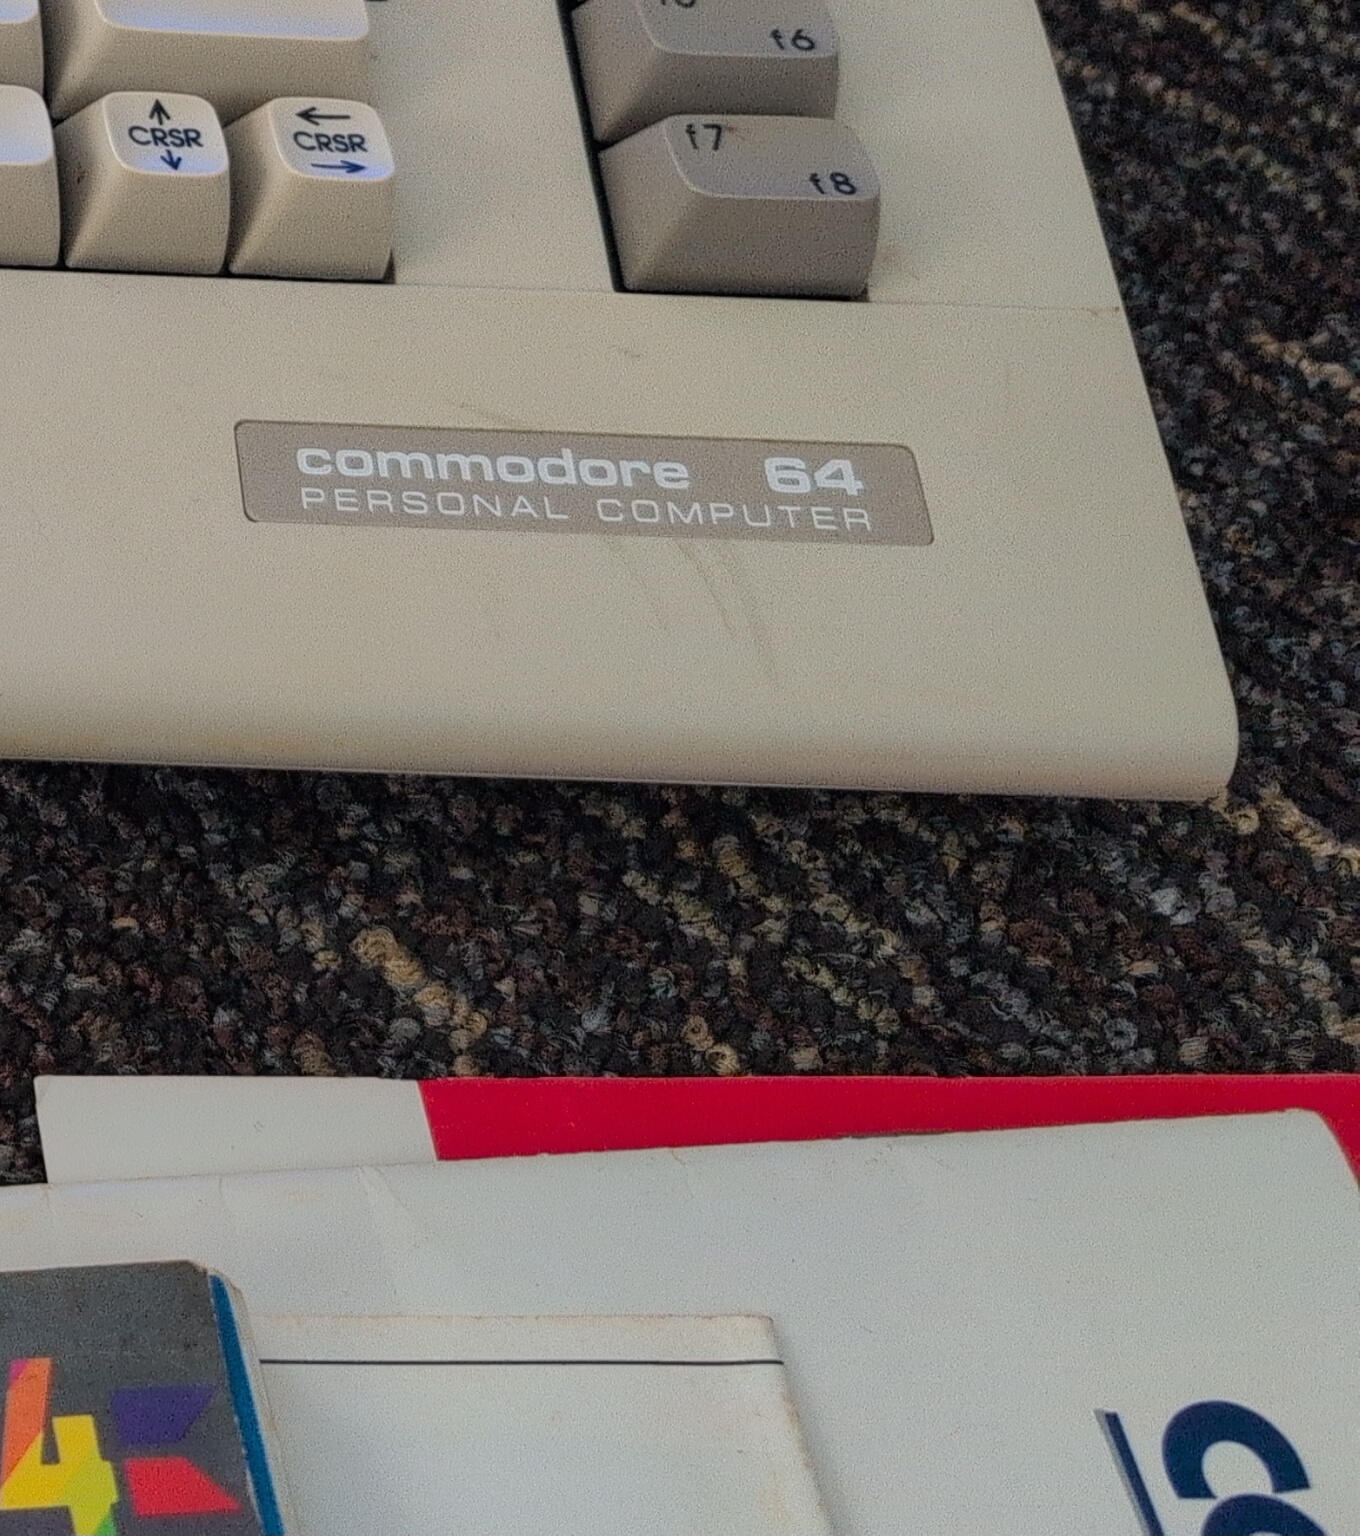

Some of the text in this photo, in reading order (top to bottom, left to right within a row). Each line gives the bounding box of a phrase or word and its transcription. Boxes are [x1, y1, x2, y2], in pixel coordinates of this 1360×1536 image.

[127, 125, 203, 148] CRSR
[292, 130, 367, 154] CRSR
[296, 446, 865, 496] commodore 64
[301, 487, 872, 533] PERSONAL COMPUTER
